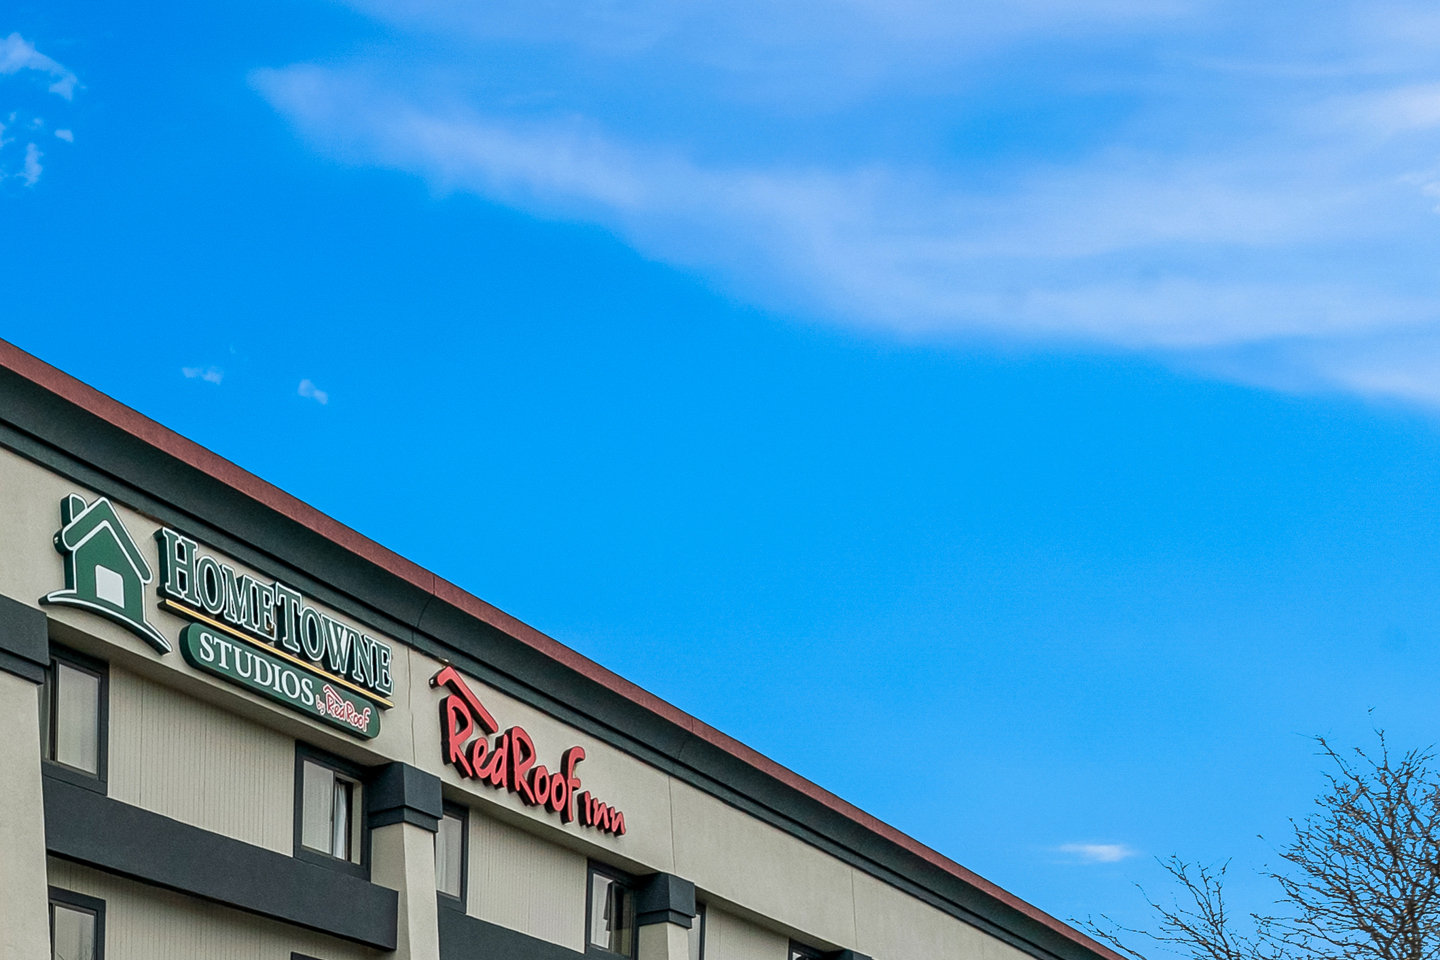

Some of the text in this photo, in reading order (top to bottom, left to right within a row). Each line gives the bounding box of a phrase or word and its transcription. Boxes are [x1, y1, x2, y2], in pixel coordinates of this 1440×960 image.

[198, 632, 315, 707] STUDIOS
[316, 692, 371, 732] by Red Roof
[445, 694, 509, 788] Red
[511, 726, 586, 823] Roof
